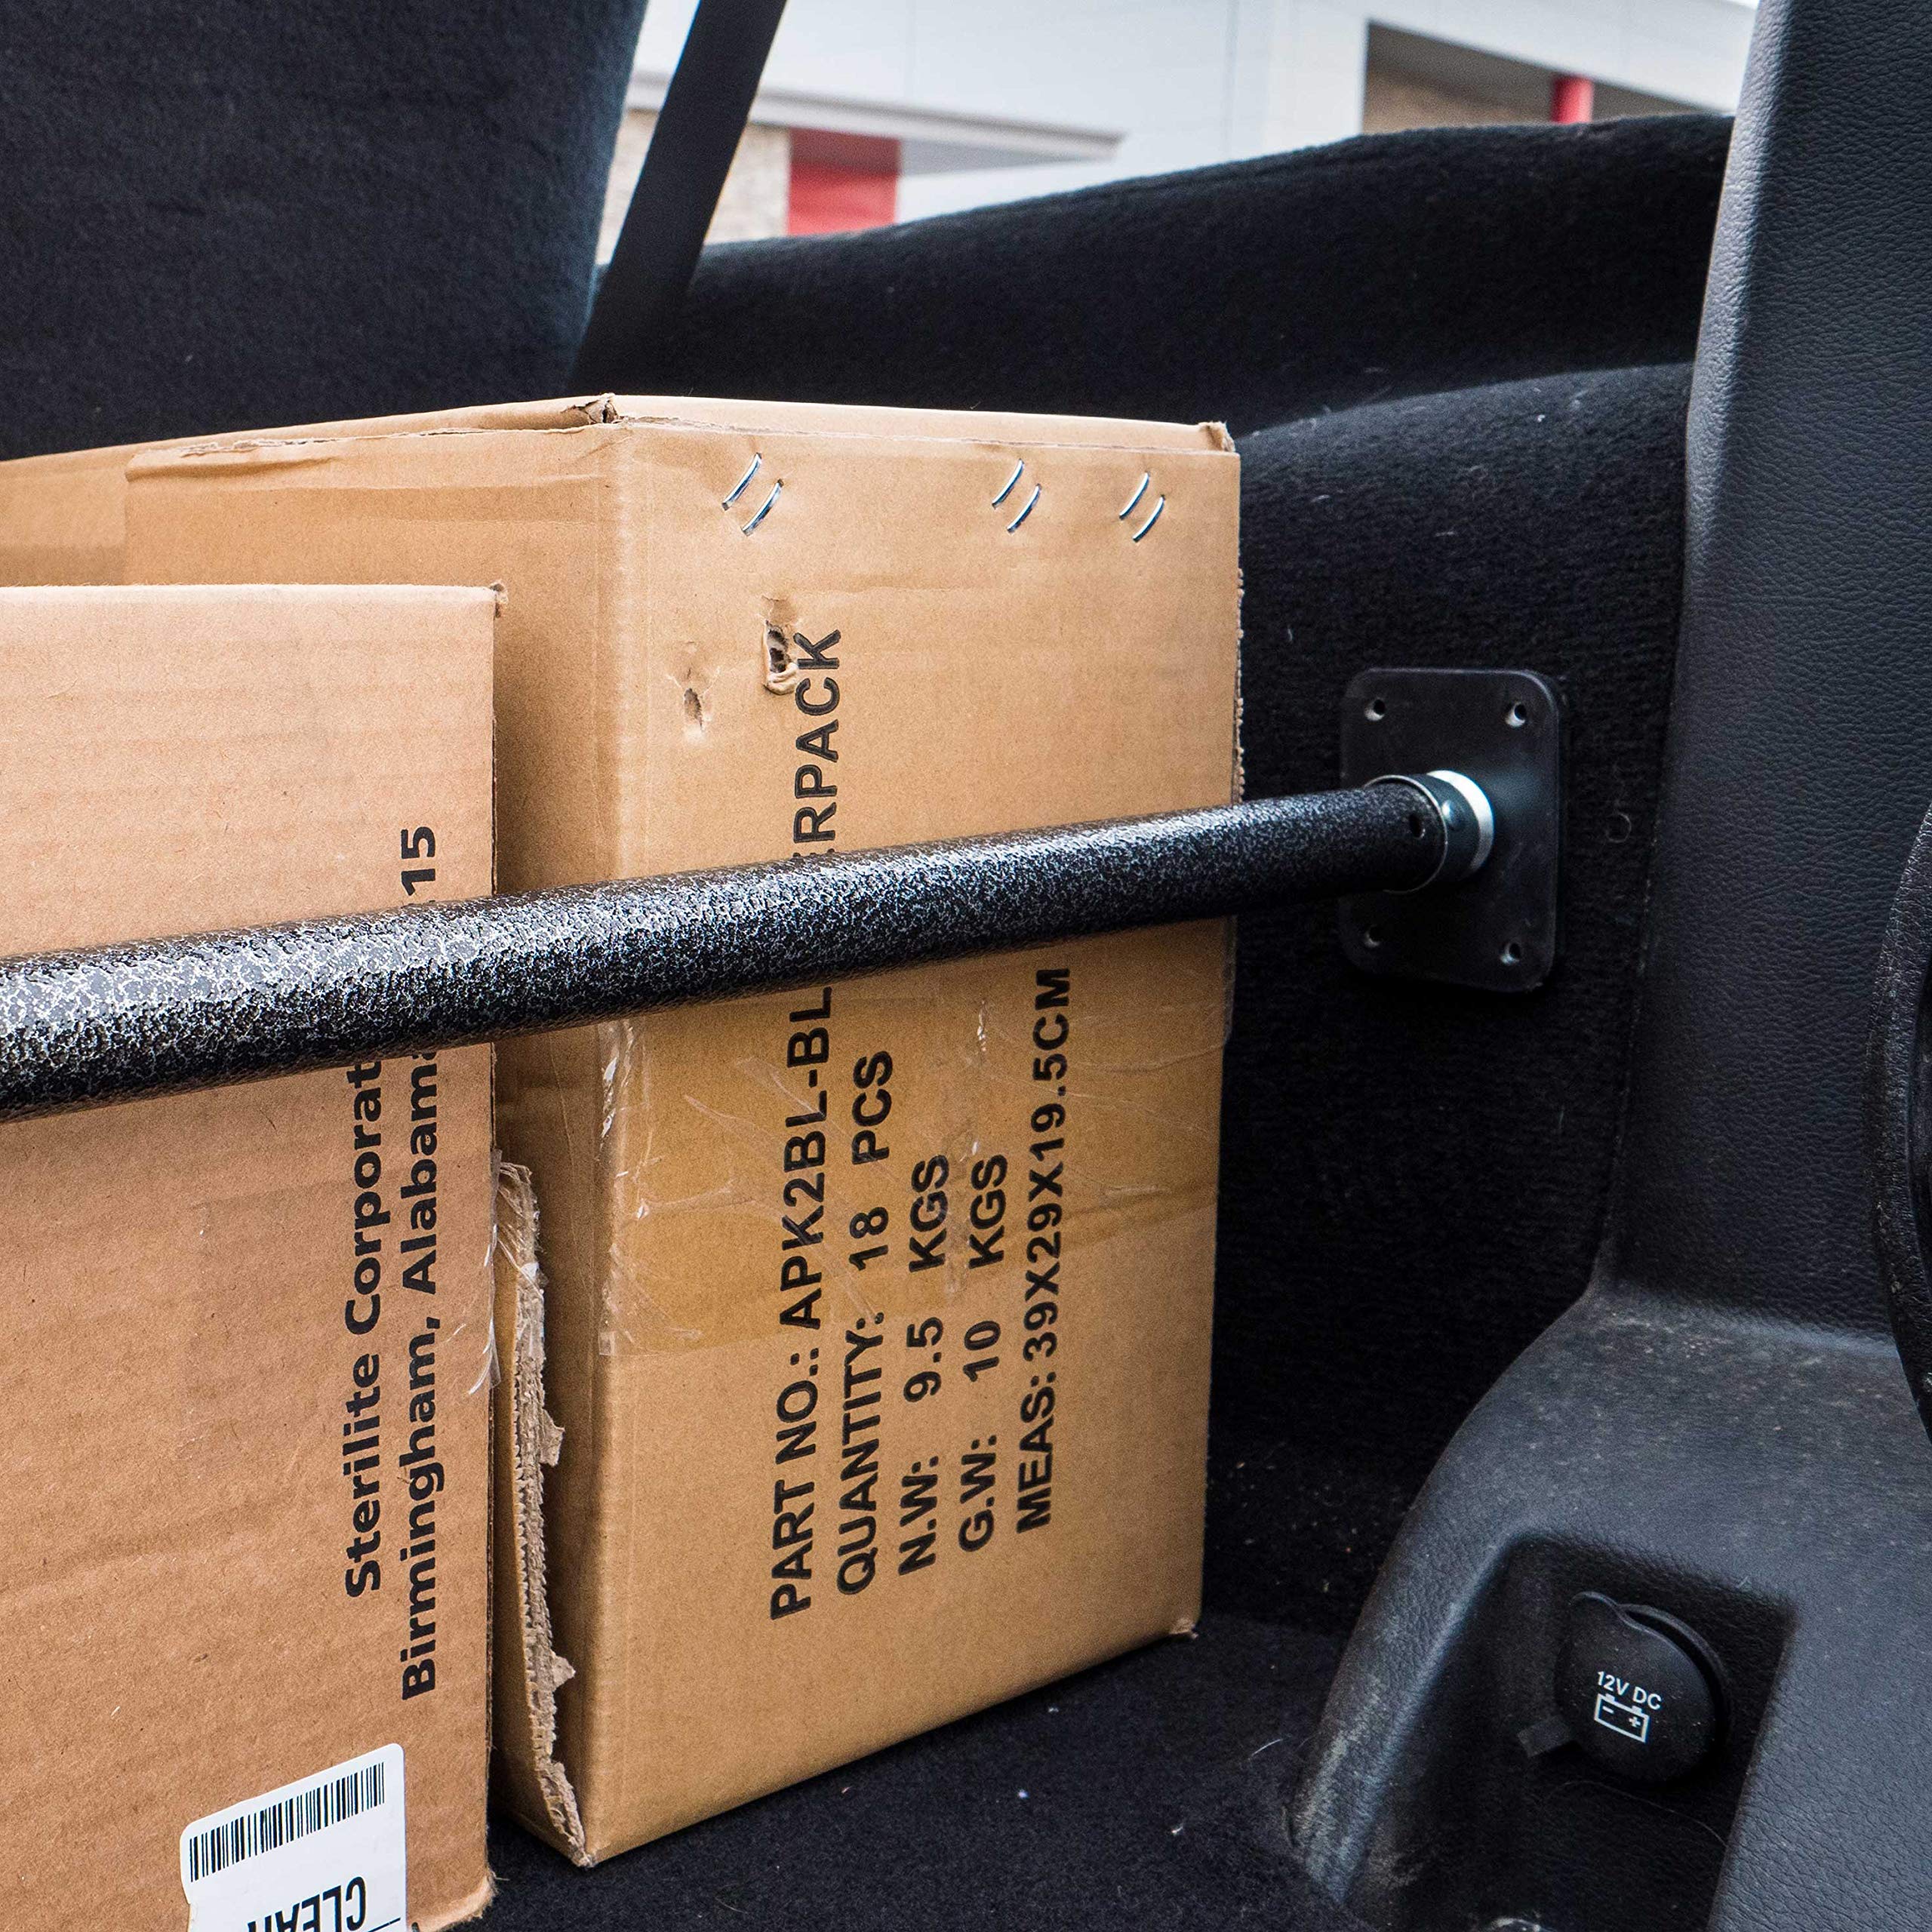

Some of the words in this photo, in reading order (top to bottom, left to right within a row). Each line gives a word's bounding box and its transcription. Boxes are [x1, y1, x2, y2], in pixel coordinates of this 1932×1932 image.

[793, 629, 841, 853] RPACK
[780, 986, 832, 1330] APK2BL-BL
[851, 1051, 893, 1164] PCS
[1023, 968, 1070, 1361] 39X29X19.5CM
[345, 1060, 390, 1335] Corporat
[401, 1049, 438, 1295] Alabam
[909, 1155, 949, 1272] KGS
[968, 1154, 1008, 1269] KGS
[849, 1207, 888, 1271] 18
[776, 1348, 820, 1464] NO.:
[903, 1317, 943, 1402] 9.5
[963, 1320, 1001, 1382] 10
[343, 1354, 381, 1598] Sterilite
[399, 1317, 445, 1700] Birmingham,
[837, 1312, 884, 1595] QUANTITY:
[958, 1435, 997, 1552] G.W:
[1016, 1371, 1057, 1533] MEAS:
[771, 1479, 815, 1620] PART
[898, 1457, 939, 1576] N.W:
[1597, 1671, 1630, 1696] 12V
[1632, 1686, 1663, 1710] DC
[248, 1876, 367, 1932] CLEA
